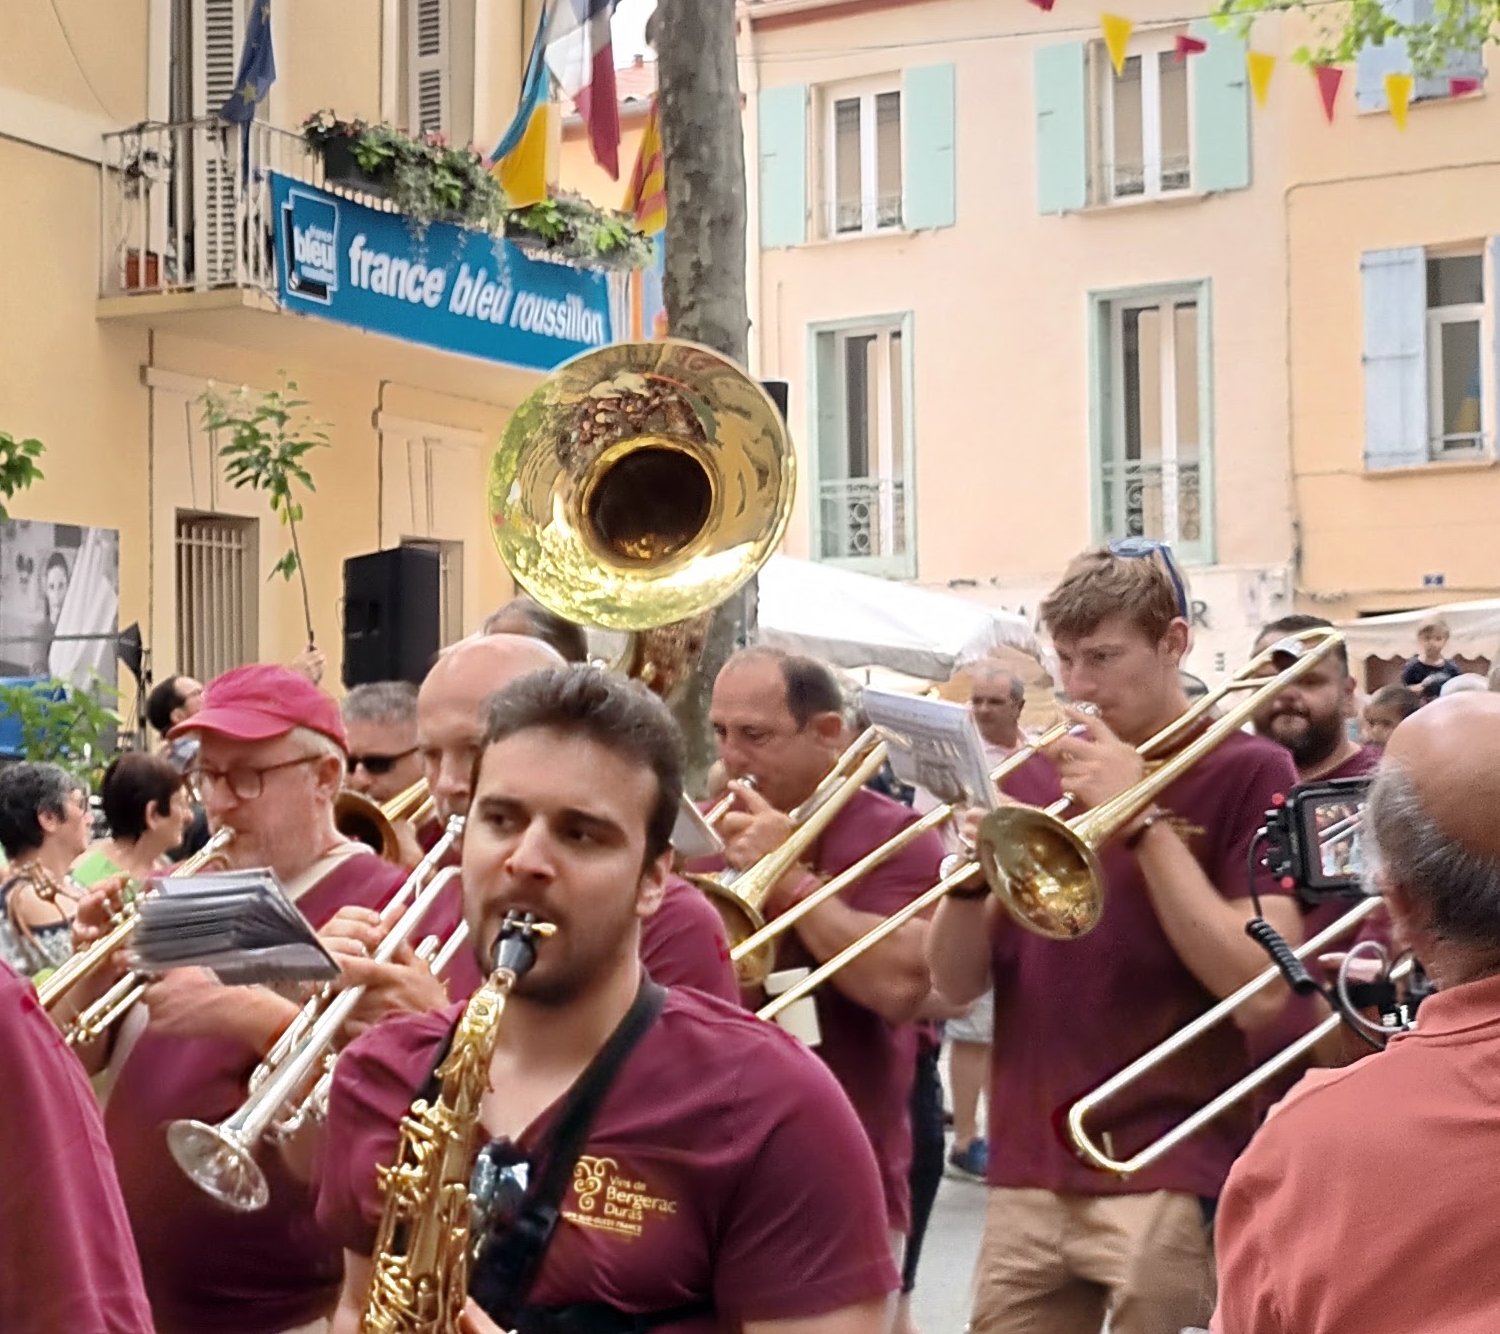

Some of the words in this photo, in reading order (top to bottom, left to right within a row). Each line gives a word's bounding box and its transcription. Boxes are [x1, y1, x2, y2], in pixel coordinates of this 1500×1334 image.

[348, 233, 447, 308] france
[448, 263, 513, 324] bleu
[509, 289, 605, 346] roussillon
[604, 1202, 643, 1221] Duras
[606, 1185, 677, 1214] Bergerac
